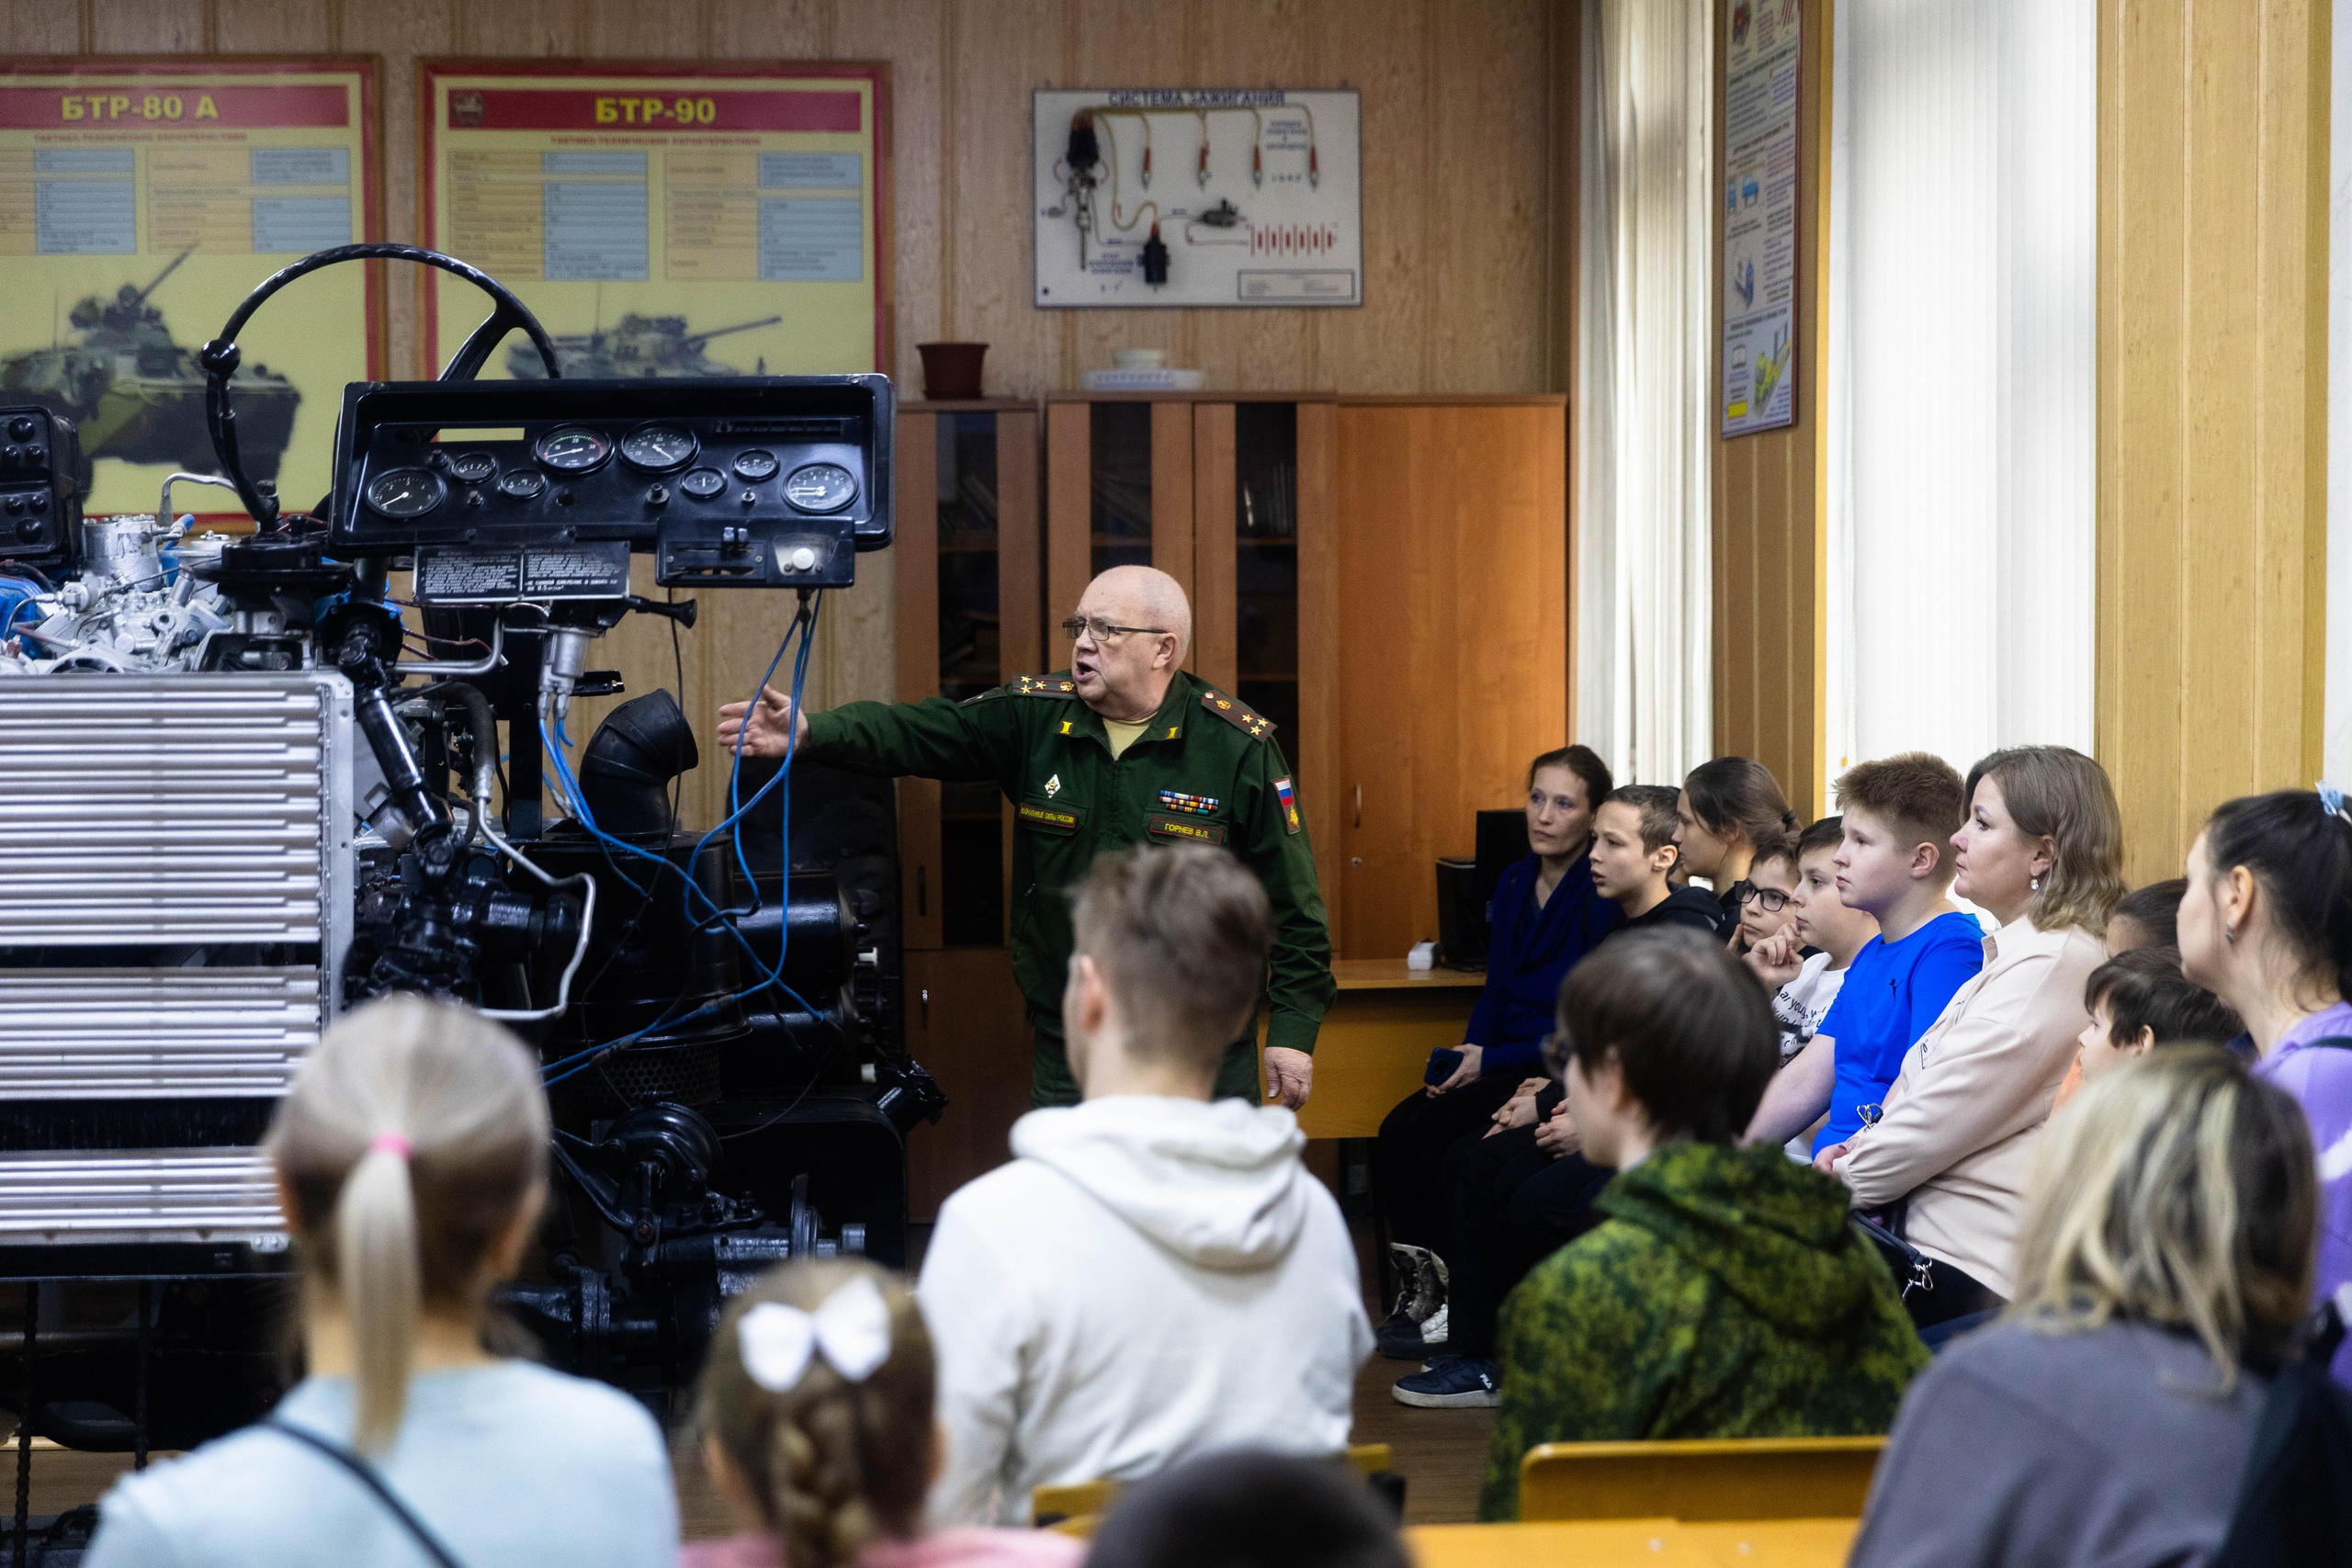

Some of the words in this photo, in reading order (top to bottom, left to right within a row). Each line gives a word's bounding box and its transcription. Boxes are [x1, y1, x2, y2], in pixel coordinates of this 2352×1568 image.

[62, 96, 184, 121] БТР-80
[594, 97, 717, 125] БТР-90
[1165, 823, 1194, 835] ГОРНЕВ
[1479, 1373, 1493, 1389] FILA
